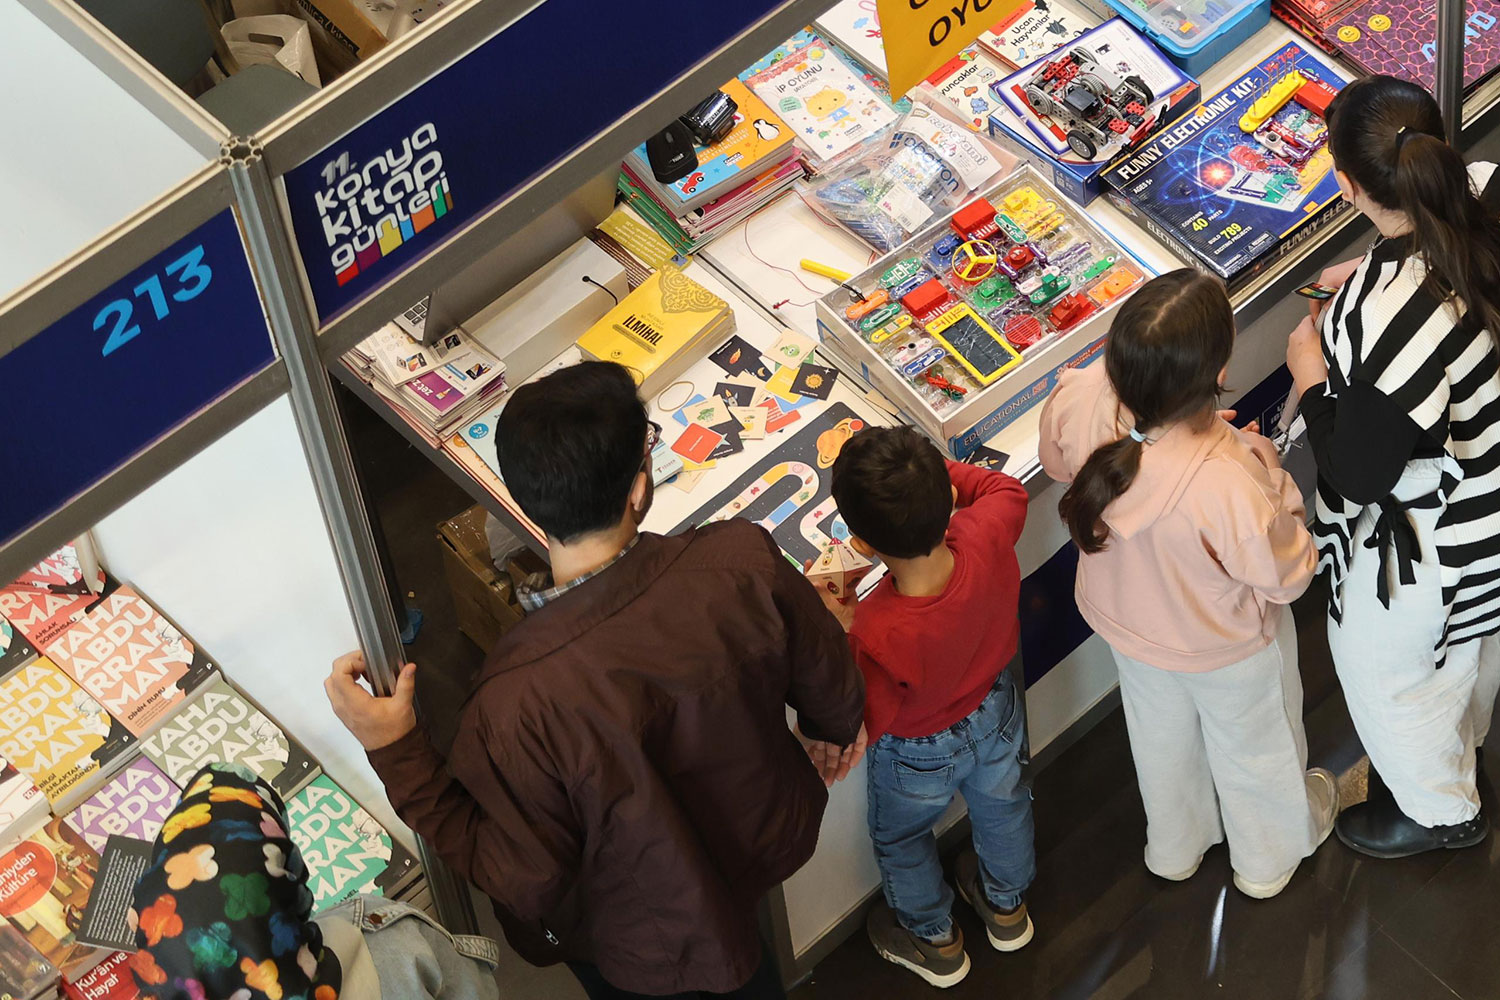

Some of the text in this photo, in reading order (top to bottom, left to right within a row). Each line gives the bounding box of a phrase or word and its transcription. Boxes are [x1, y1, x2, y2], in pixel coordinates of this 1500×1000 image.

[1009, 13, 1051, 49] Hayvanlar
[1011, 14, 1036, 36] Uçan
[775, 63, 824, 95] İP OYUNU
[1117, 75, 1258, 181] FUNNY ELECTRONIC KIT
[313, 121, 439, 218] konya
[319, 150, 358, 188] 11.
[321, 149, 444, 248] kitap
[330, 171, 450, 277] günleri
[1146, 219, 1196, 268] ELECTRONIC
[1191, 217, 1209, 233] 40
[1219, 222, 1242, 241] 789
[91, 243, 213, 358] 213
[622, 313, 664, 347] İLMİHAL
[963, 391, 1032, 447] EDUCATIONAL
[34, 621, 59, 641] AHLAK
[45, 593, 137, 662] TAHA
[72, 598, 155, 682] ABDU
[139, 691, 233, 759] TAHA
[163, 696, 248, 777] ABDU
[45, 764, 82, 795] AHLAKTAN
[63, 767, 154, 836] TAHA
[111, 951, 128, 965] ve
[85, 973, 120, 1000] Hayat
